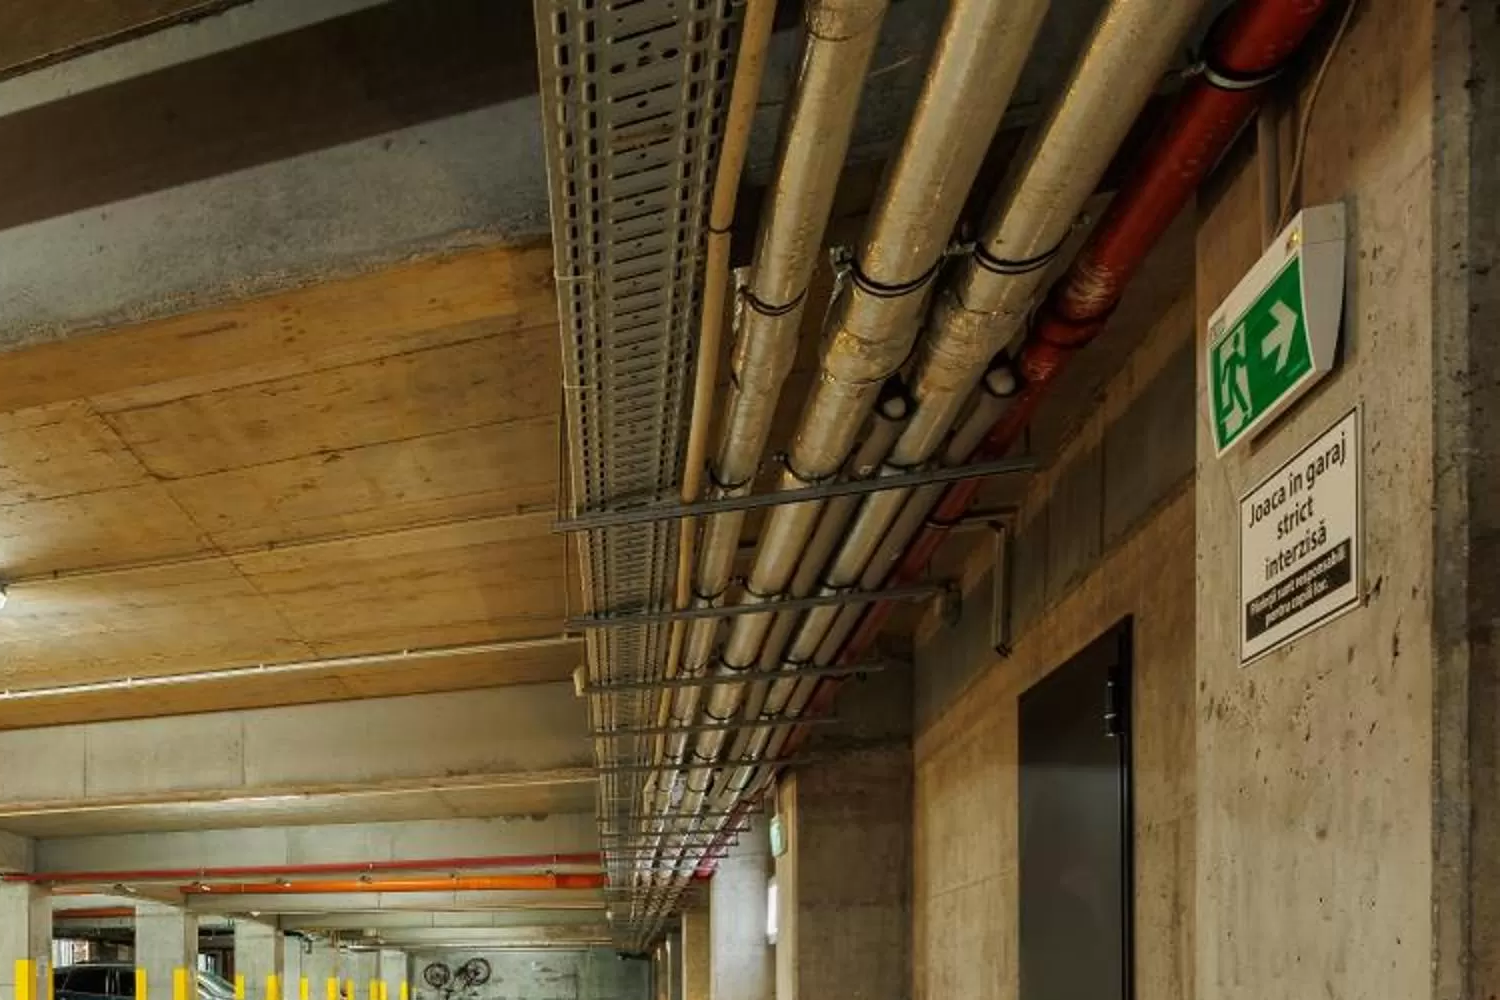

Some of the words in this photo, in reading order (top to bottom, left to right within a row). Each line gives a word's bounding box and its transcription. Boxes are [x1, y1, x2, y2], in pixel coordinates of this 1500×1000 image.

[1249, 486, 1287, 530] Joaca
[1305, 431, 1346, 491] garaj
[1277, 495, 1314, 540] strict
